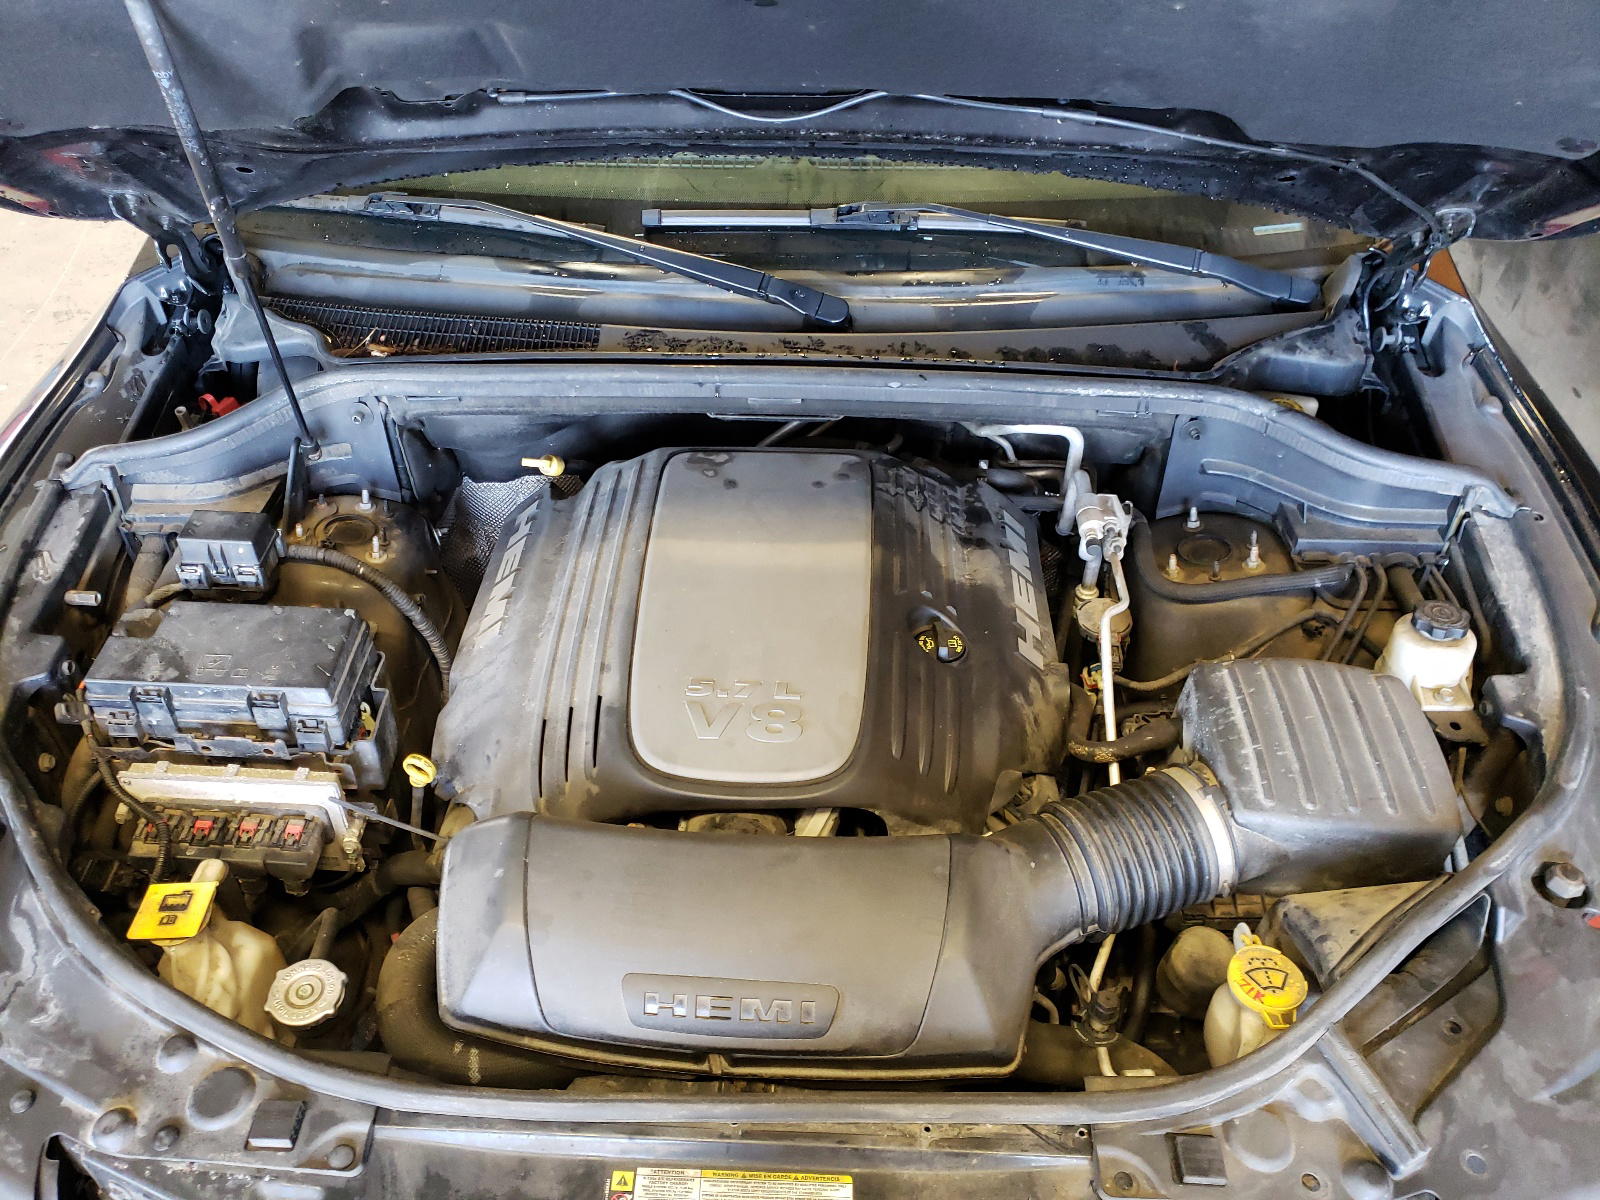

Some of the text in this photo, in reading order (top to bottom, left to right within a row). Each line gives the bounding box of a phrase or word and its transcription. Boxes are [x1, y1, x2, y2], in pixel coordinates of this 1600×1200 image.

[474, 500, 540, 649] HEMI
[1003, 510, 1044, 671] HEMI
[685, 678, 802, 700] 5.7 L
[683, 700, 803, 743] V8
[644, 992, 816, 1024] HEMI
